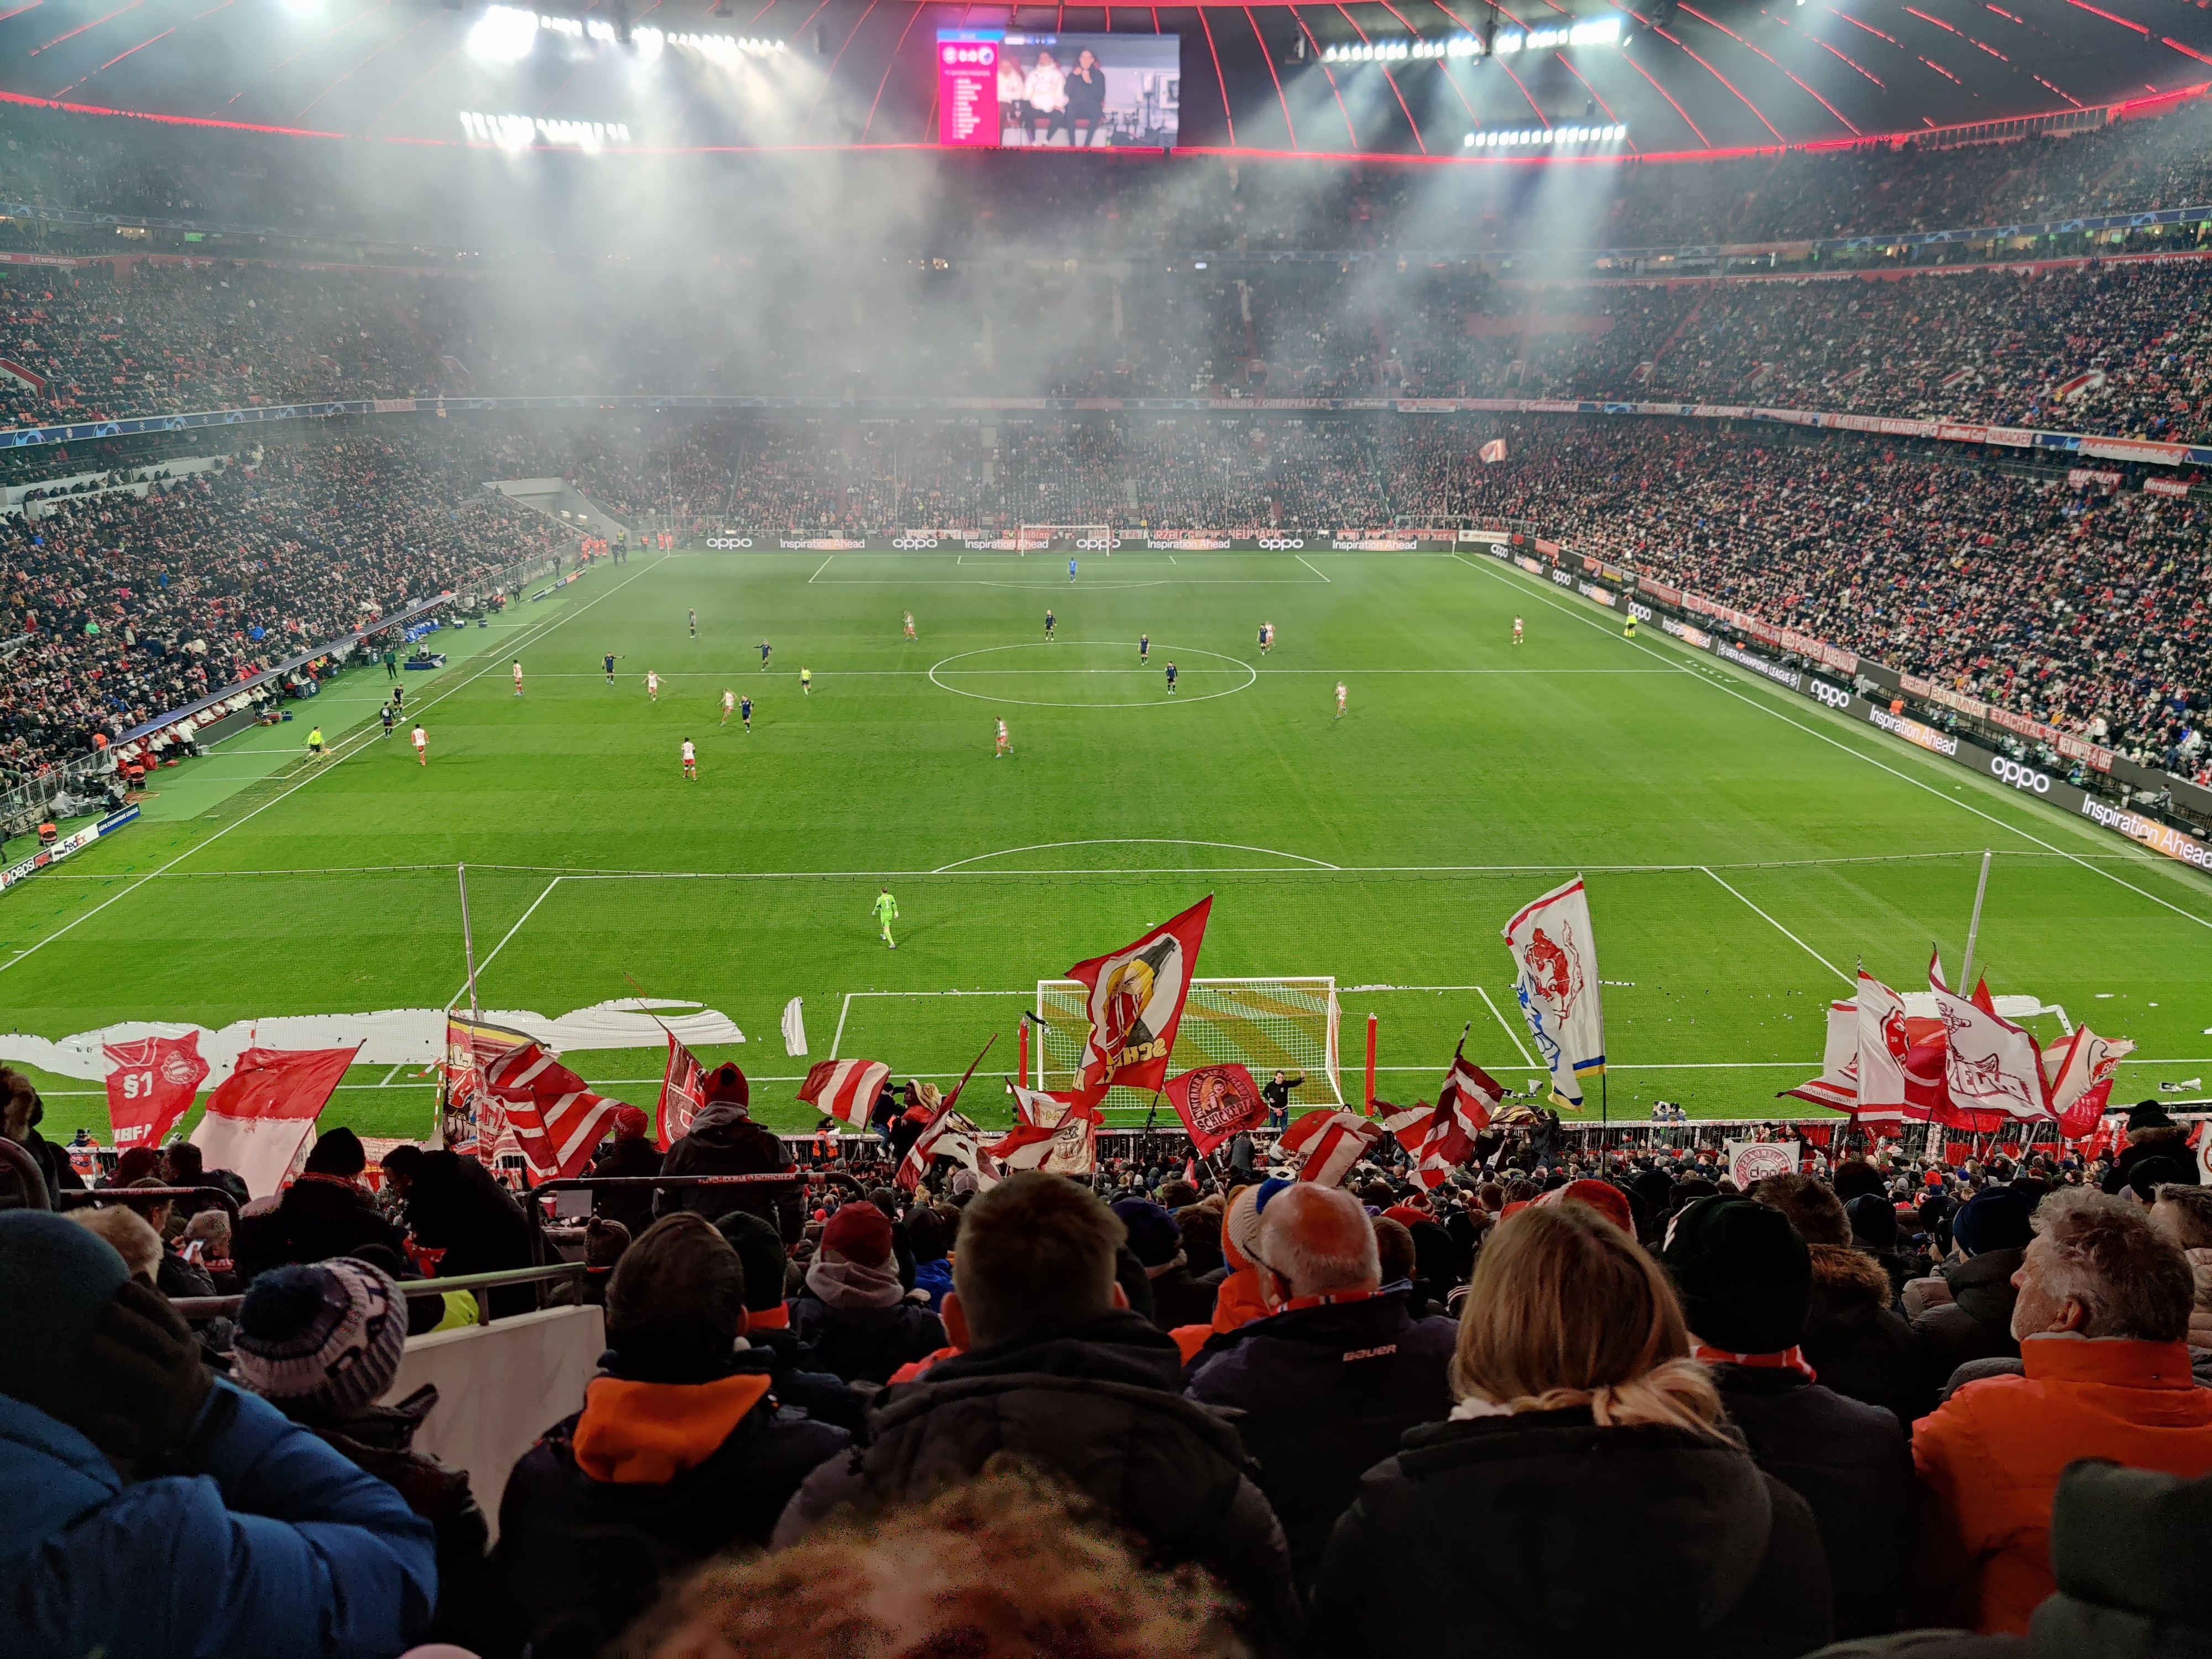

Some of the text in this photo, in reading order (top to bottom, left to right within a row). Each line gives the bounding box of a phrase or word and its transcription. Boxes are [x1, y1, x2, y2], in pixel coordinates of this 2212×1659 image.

[706, 538, 753, 550] oppo
[780, 539, 865, 550] Inspiration Ahead
[893, 539, 938, 550] oppo
[965, 539, 1049, 551] Inspiration Ahead
[1076, 539, 1121, 550] oppo
[1147, 539, 1230, 550] Inspiration Ahead
[1259, 539, 1304, 551] oppo
[1333, 539, 1417, 551] Inspiration Ahead
[1726, 646, 1790, 683] UEFA CHAMPIONS LEAGUE
[1811, 680, 1850, 708] oppo
[1932, 687, 1986, 717] BAD IMNAU
[1869, 703, 1958, 755] Inspiration Ahead
[1991, 710, 2043, 740] EYACHTAL
[1991, 756, 2049, 793] oppo
[108, 815, 126, 827] CHAMPIONS
[127, 807, 139, 819] LEAGUE
[2082, 794, 2212, 869] Inspiration Ahead
[64, 833, 87, 854] FedEx
[11, 857, 35, 884] pepsi
[885, 899, 890, 910] 1
[123, 1071, 153, 1099] §1
